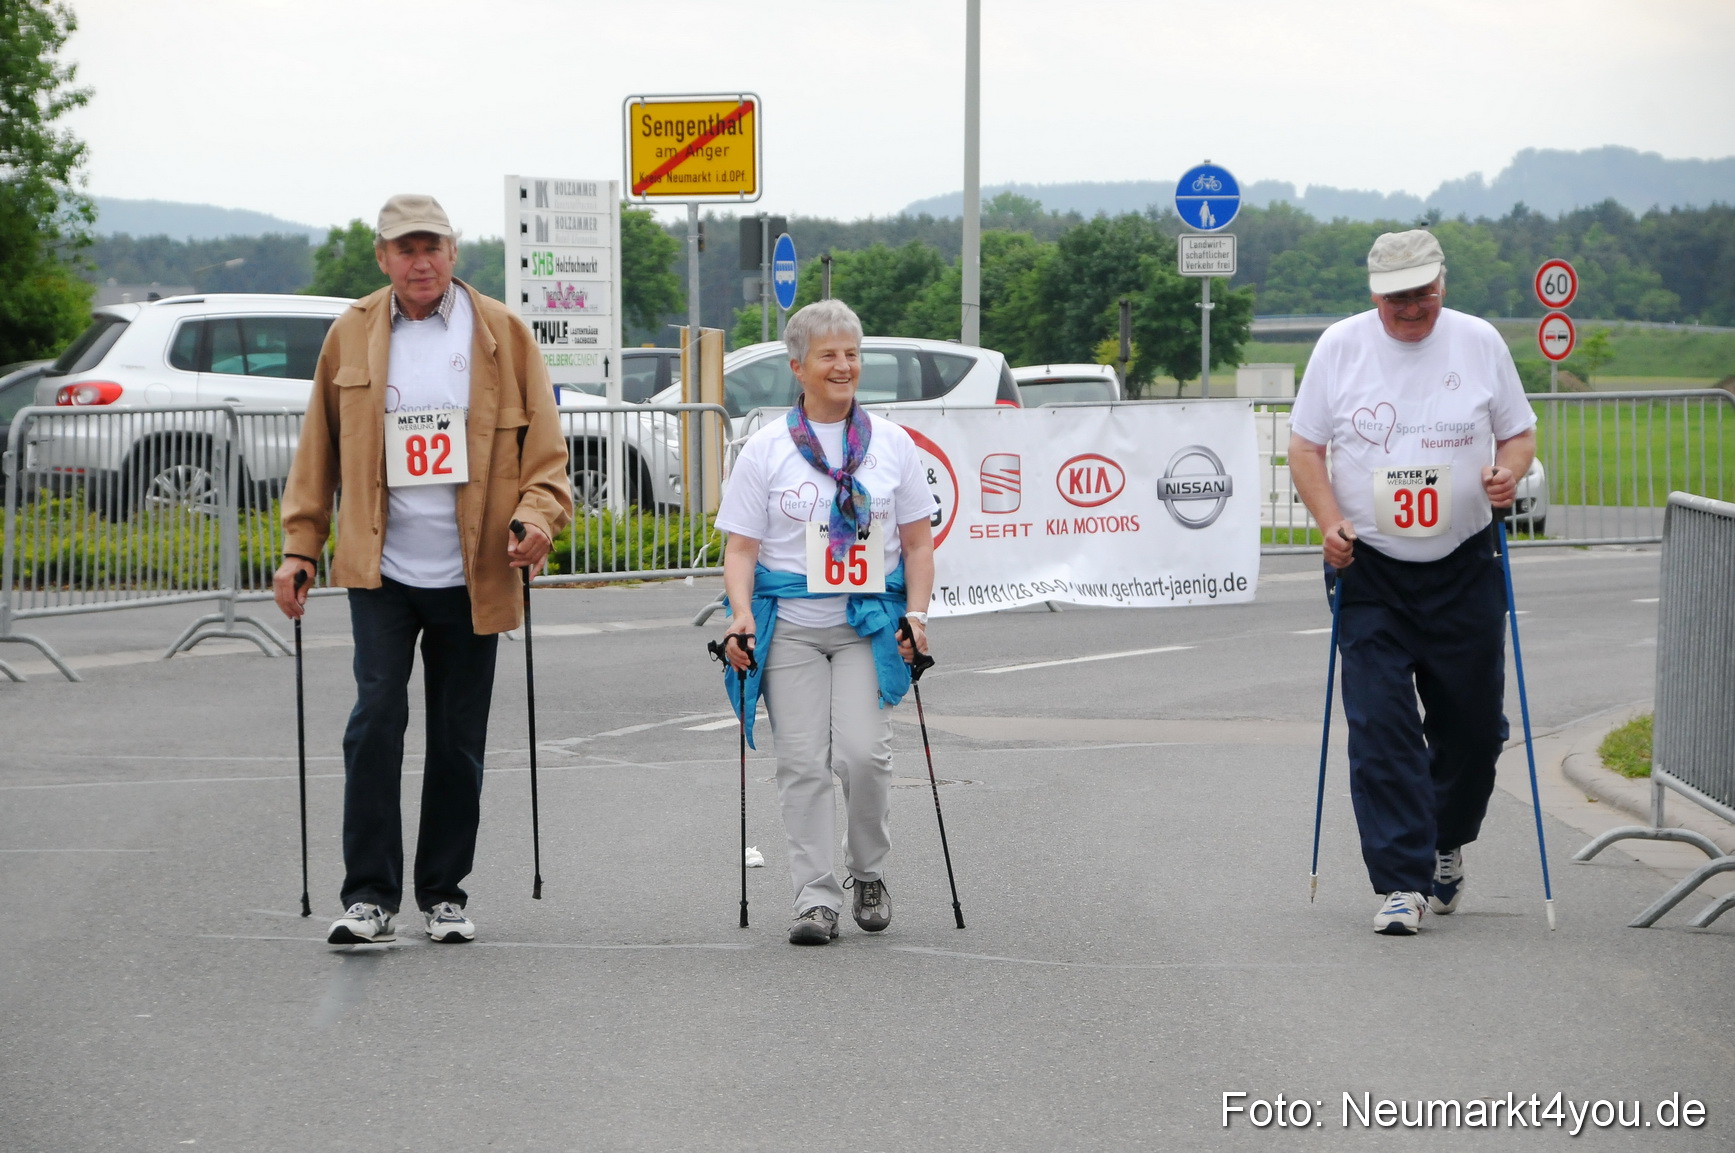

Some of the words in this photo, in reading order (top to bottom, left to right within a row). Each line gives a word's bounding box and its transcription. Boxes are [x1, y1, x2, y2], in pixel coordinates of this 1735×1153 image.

[642, 113, 744, 143] Sengenthal
[655, 147, 678, 158] am
[685, 144, 730, 161] Anger
[639, 171, 662, 183] Kreis
[667, 171, 712, 183] Neumarkt
[554, 181, 597, 197] HOLZAMMER
[555, 215, 598, 231] HOLZAMMER
[1189, 240, 1226, 249] Landwirt-
[1186, 250, 1230, 260] schaftlicher
[532, 251, 554, 276] SHB
[555, 256, 598, 273] Holzfachmarkt
[1185, 260, 1214, 270] Verkehr
[1217, 260, 1230, 270] frei
[1545, 273, 1568, 295] 60
[532, 320, 568, 345] THULE
[398, 414, 434, 425] MEYER
[398, 422, 435, 431] WERBUNG
[1358, 420, 1383, 431] Herz
[1396, 423, 1425, 436] Sport
[1435, 421, 1475, 433] Gruppe
[1421, 436, 1474, 448] Neumarkt
[405, 433, 453, 477] 82
[1068, 466, 1113, 496] KIA
[1387, 470, 1423, 479] MEYER
[1165, 480, 1226, 496] NISSAN
[784, 499, 807, 510] Herz
[1394, 487, 1439, 529] 30
[969, 523, 1034, 539] SEAT
[1046, 518, 1069, 536] KIA
[1073, 515, 1141, 535] MOTORS
[825, 544, 868, 586] 65
[940, 585, 966, 607] Tel.
[968, 583, 1034, 606] 09181/26
[1073, 571, 1248, 602] www.gerhart-jaenig.de
